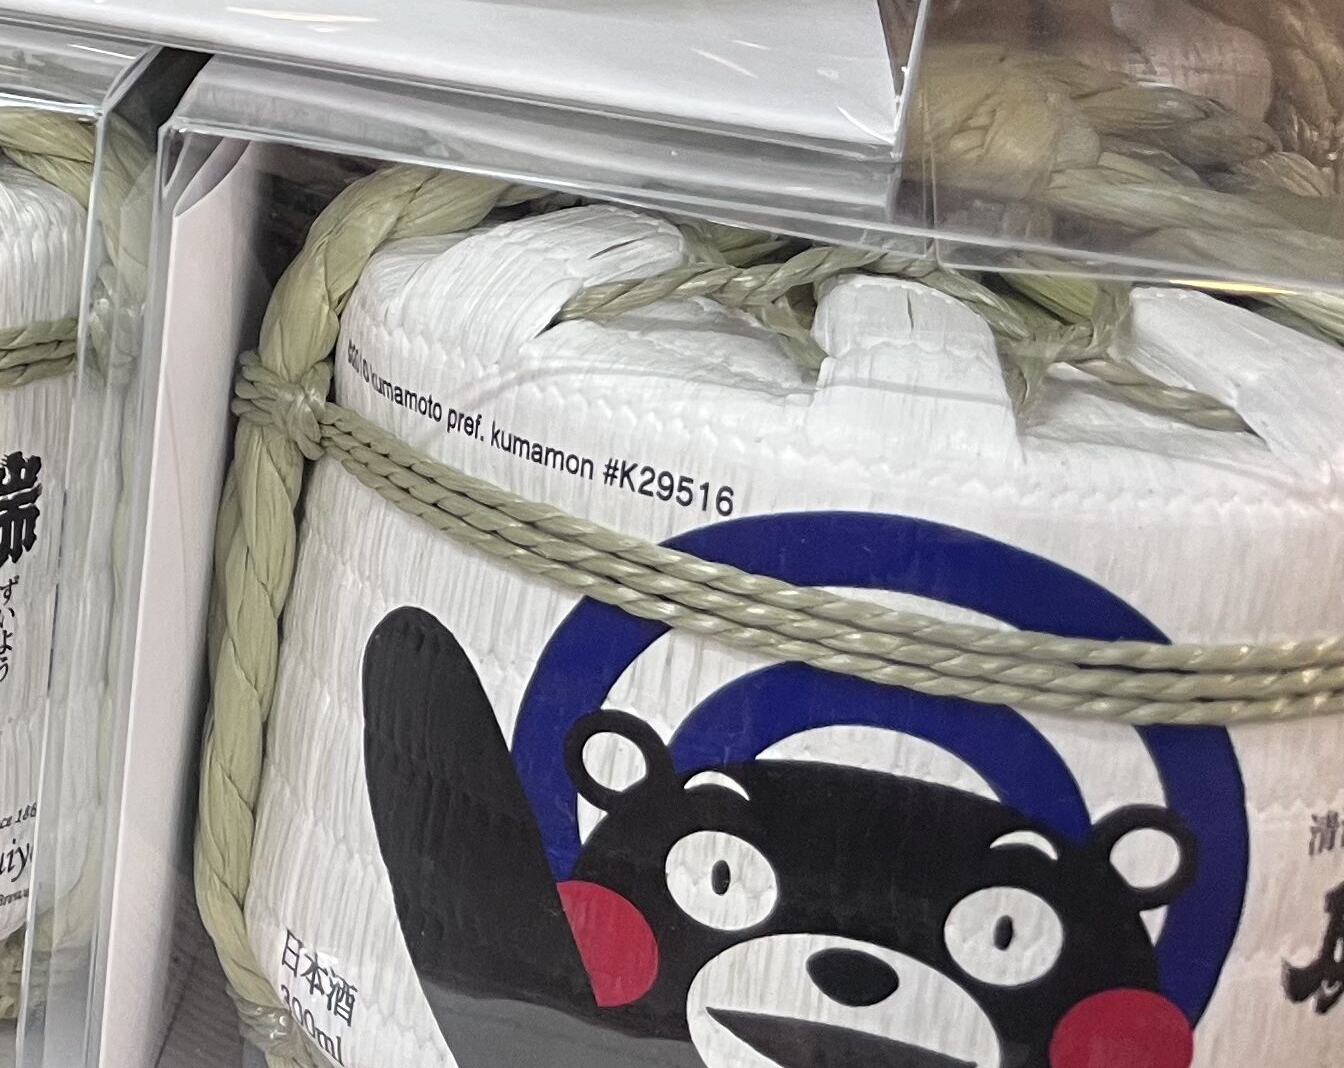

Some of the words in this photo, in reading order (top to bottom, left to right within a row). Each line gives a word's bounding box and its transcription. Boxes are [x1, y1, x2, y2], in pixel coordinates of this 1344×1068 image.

[446, 407, 484, 442] pref.
[490, 416, 594, 480] kumamon
[602, 458, 734, 517] #K29516
[15, 802, 37, 824] 186
[281, 927, 358, 1027] 日本酒
